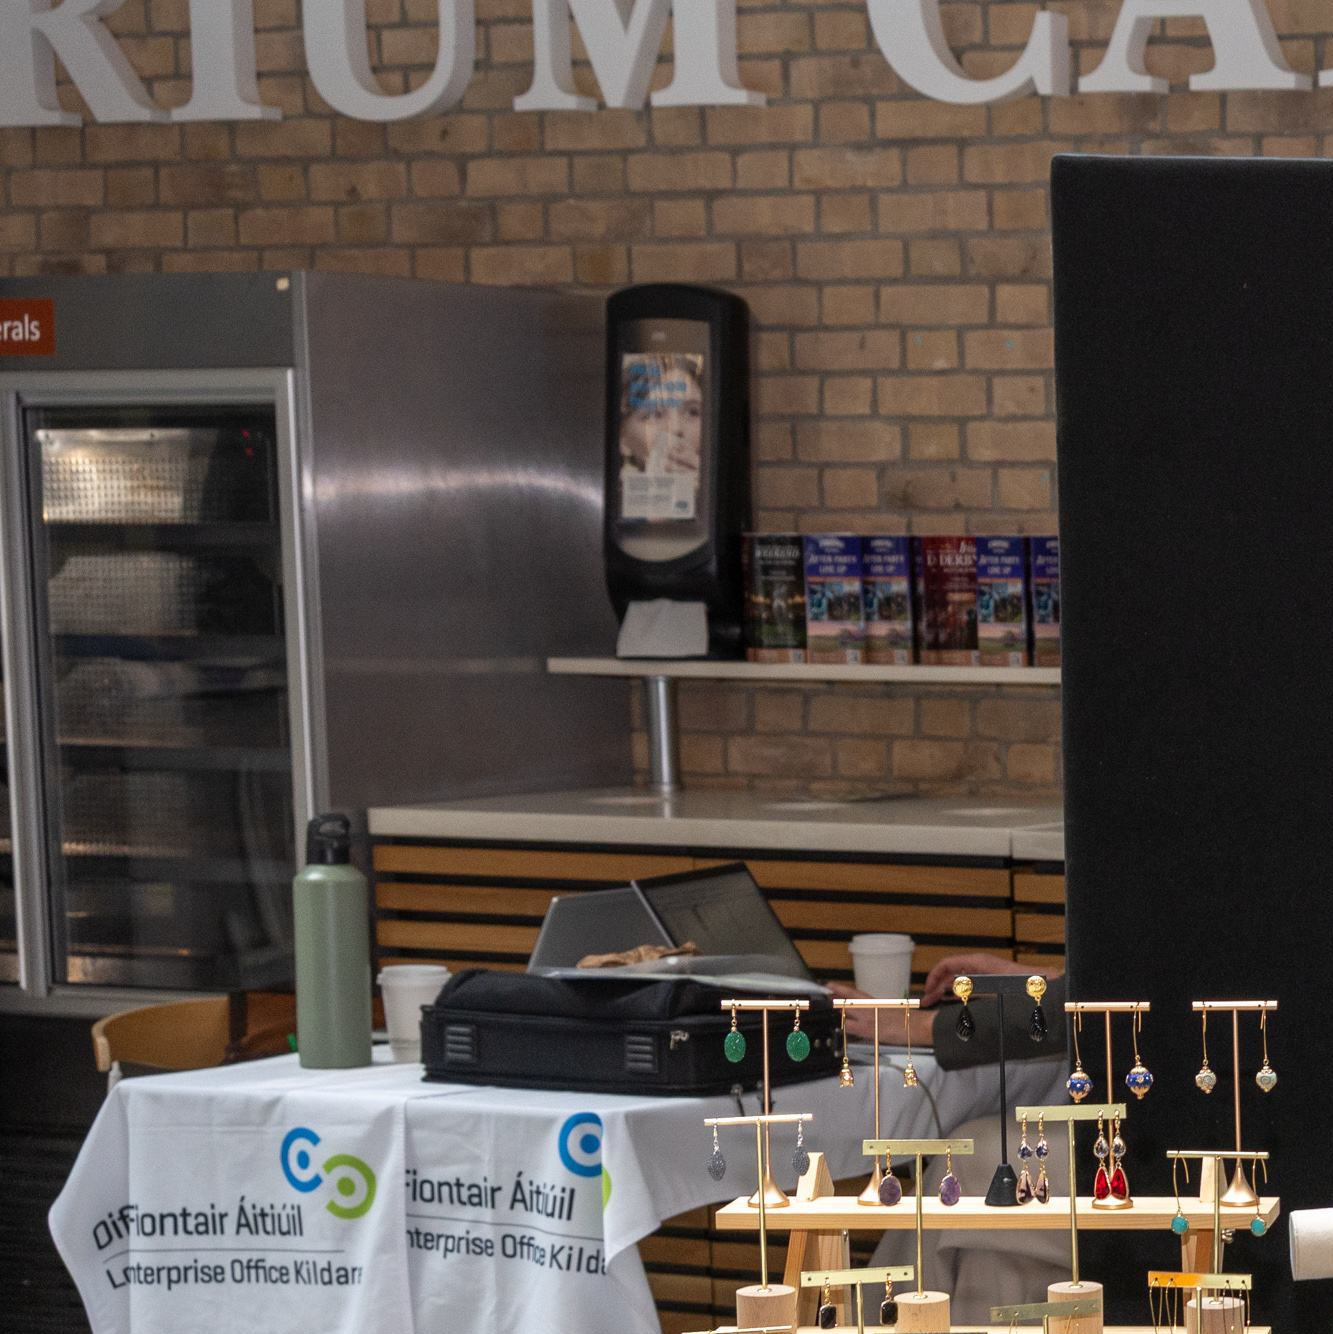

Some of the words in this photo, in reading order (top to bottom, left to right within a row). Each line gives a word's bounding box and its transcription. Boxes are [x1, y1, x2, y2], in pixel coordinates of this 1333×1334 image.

[404, 1169, 502, 1211] iontair
[235, 1195, 304, 1238] Áitiúil
[405, 1226, 496, 1260] nterprise
[549, 1242, 606, 1276] Kild
[128, 1258, 225, 1291] nterprise
[230, 1258, 290, 1285] Office
